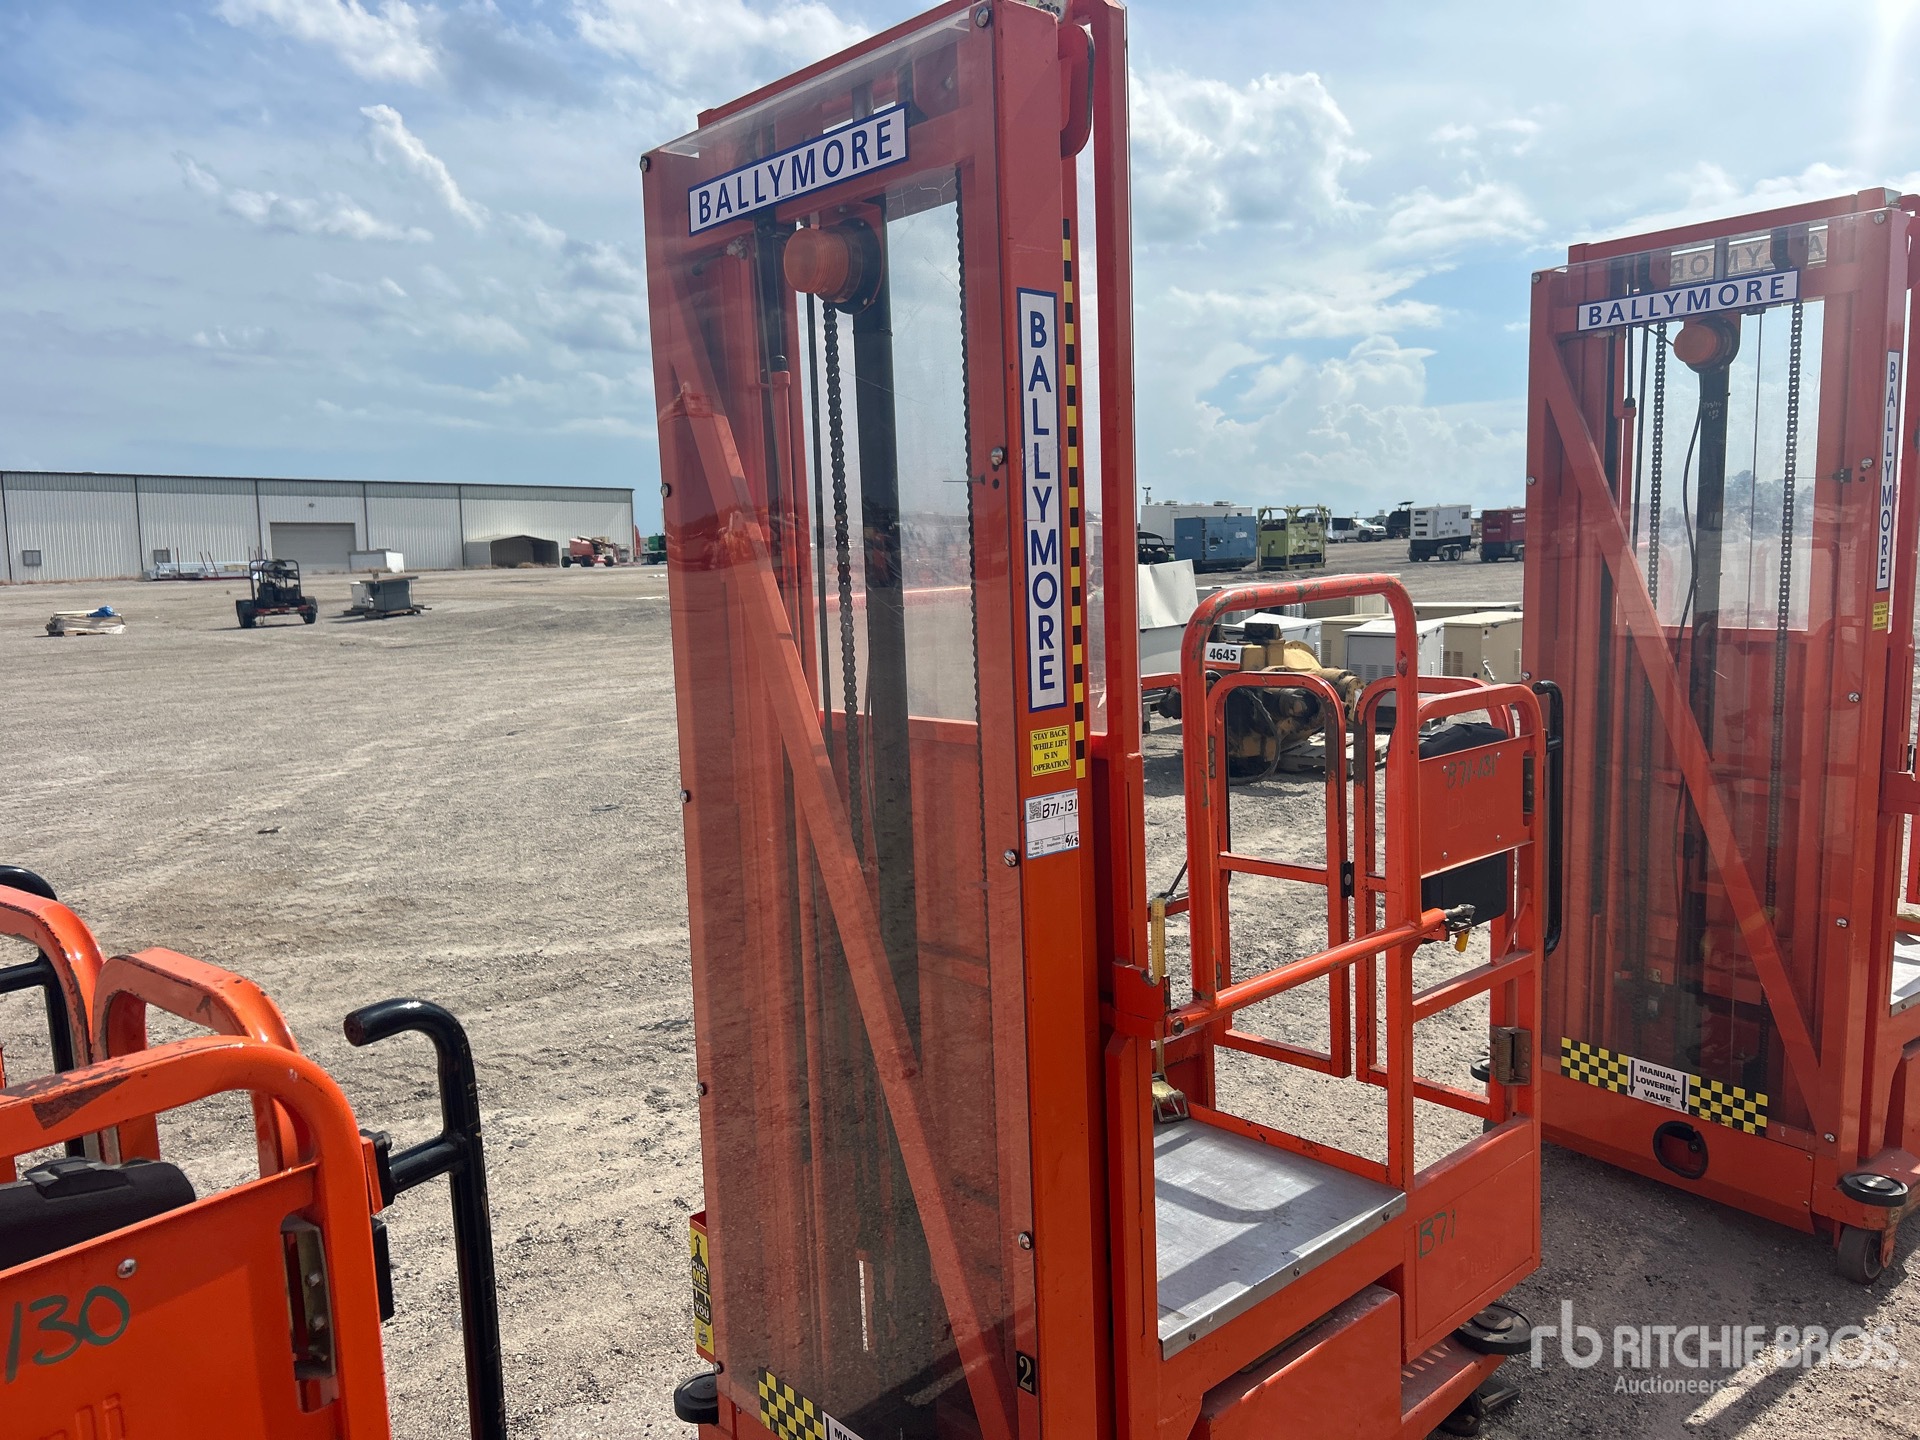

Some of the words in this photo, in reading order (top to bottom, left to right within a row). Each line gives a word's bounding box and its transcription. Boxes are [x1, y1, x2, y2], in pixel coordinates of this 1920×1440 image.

[699, 119, 892, 225] BALLYMORE
[1588, 276, 1785, 326] BALLYMORE
[1879, 361, 1896, 579] BALLYMORE
[1028, 311, 1057, 690] BALLYMORE
[1209, 648, 1237, 661] 4645
[1033, 732, 1048, 740] STAY
[1050, 729, 1067, 738] BACK
[1033, 742, 1053, 751] WHILE
[1055, 739, 1067, 747] LIFT
[1033, 759, 1069, 772] OPERATION
[1044, 752, 1050, 760] IS
[1042, 799, 1078, 818] B71-131
[1639, 1065, 1677, 1082] MANUAL
[1635, 1075, 1681, 1095] LOWERING
[1643, 1089, 1672, 1104] VALVE
[1419, 1208, 1456, 1258] B71
[692, 1260, 707, 1275] PLUG
[692, 1267, 708, 1288] ME
[695, 1302, 710, 1319] YOU
[5, 1285, 130, 1384] 130
[1020, 1356, 1032, 1391] 2
